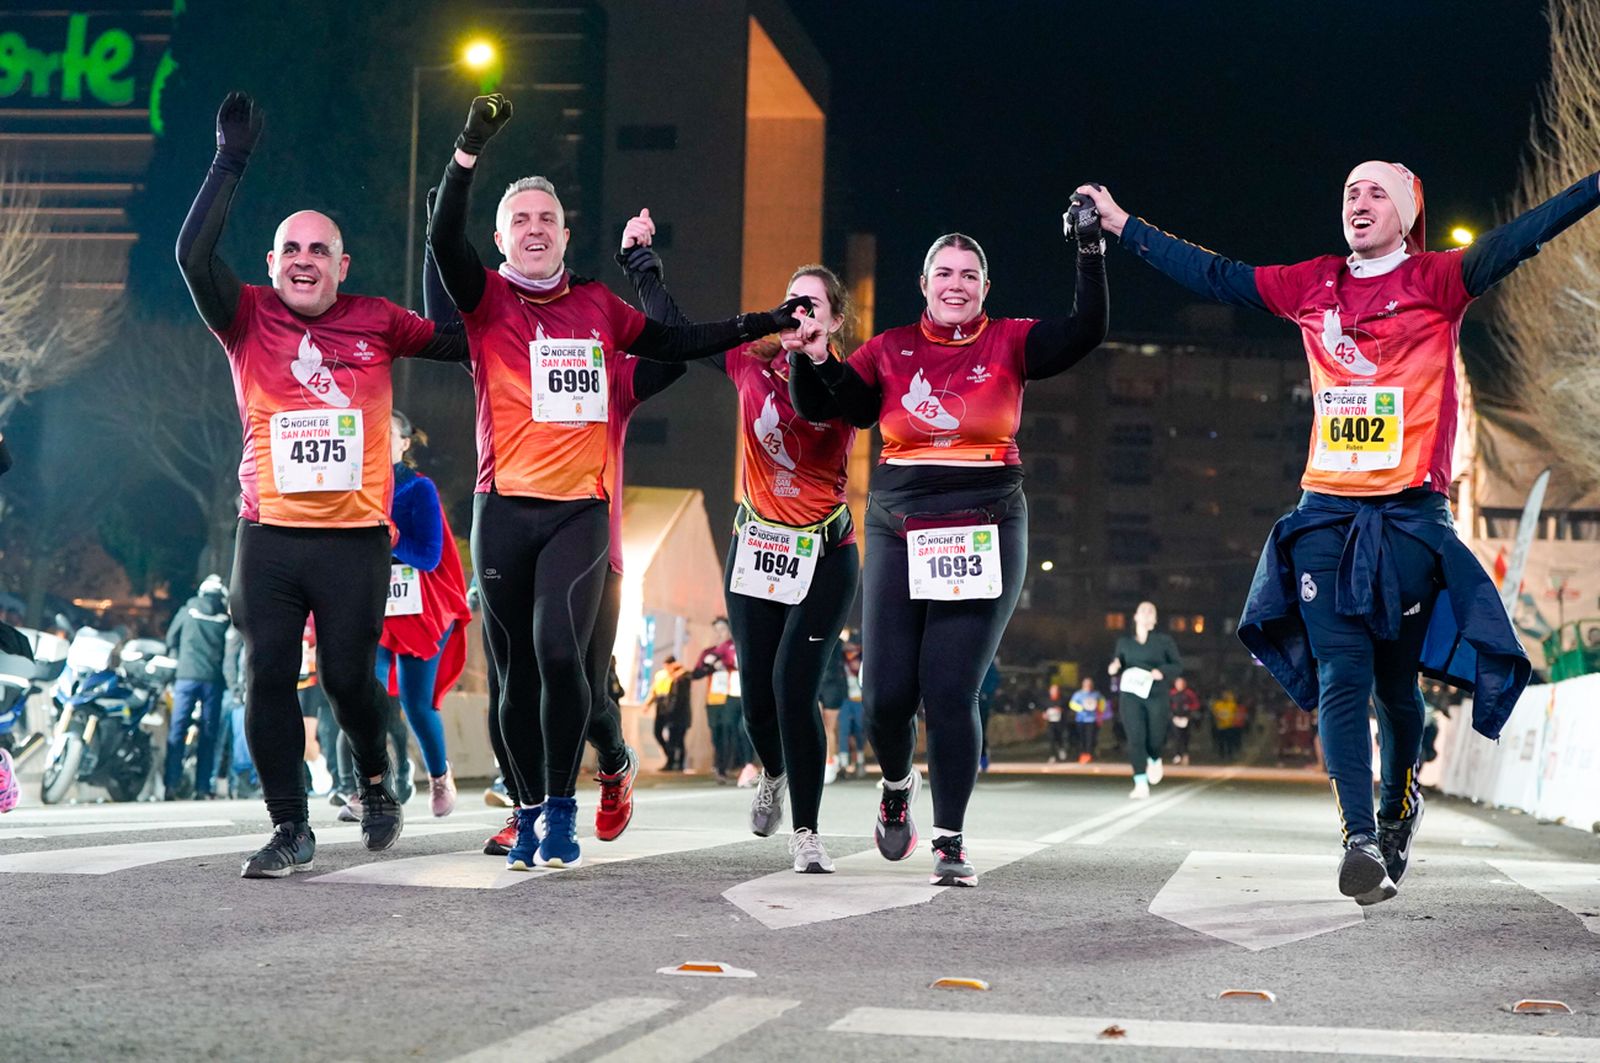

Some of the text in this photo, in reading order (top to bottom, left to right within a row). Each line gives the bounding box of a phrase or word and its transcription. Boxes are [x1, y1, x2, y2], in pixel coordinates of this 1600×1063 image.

[577, 349, 586, 357] DE
[1335, 342, 1356, 364] 43
[541, 359, 559, 367] SAN
[307, 372, 331, 394] 43
[548, 369, 600, 393] 6998
[1357, 396, 1367, 405] DE
[915, 401, 939, 419] 43
[1340, 405, 1367, 416] ANTÓN
[291, 419, 329, 428] NOCHE DE
[281, 430, 298, 440] SAN
[1330, 417, 1385, 442] 6402
[763, 432, 782, 454] 43
[290, 439, 347, 463] 4375
[775, 479, 790, 487] SAN
[747, 537, 761, 548] SAN
[757, 532, 779, 542] NOCHE
[780, 536, 790, 544] DE
[927, 536, 965, 545] NOCHE DE
[918, 547, 935, 556] SAN
[753, 550, 800, 579] 1694
[927, 554, 982, 578] 1693
